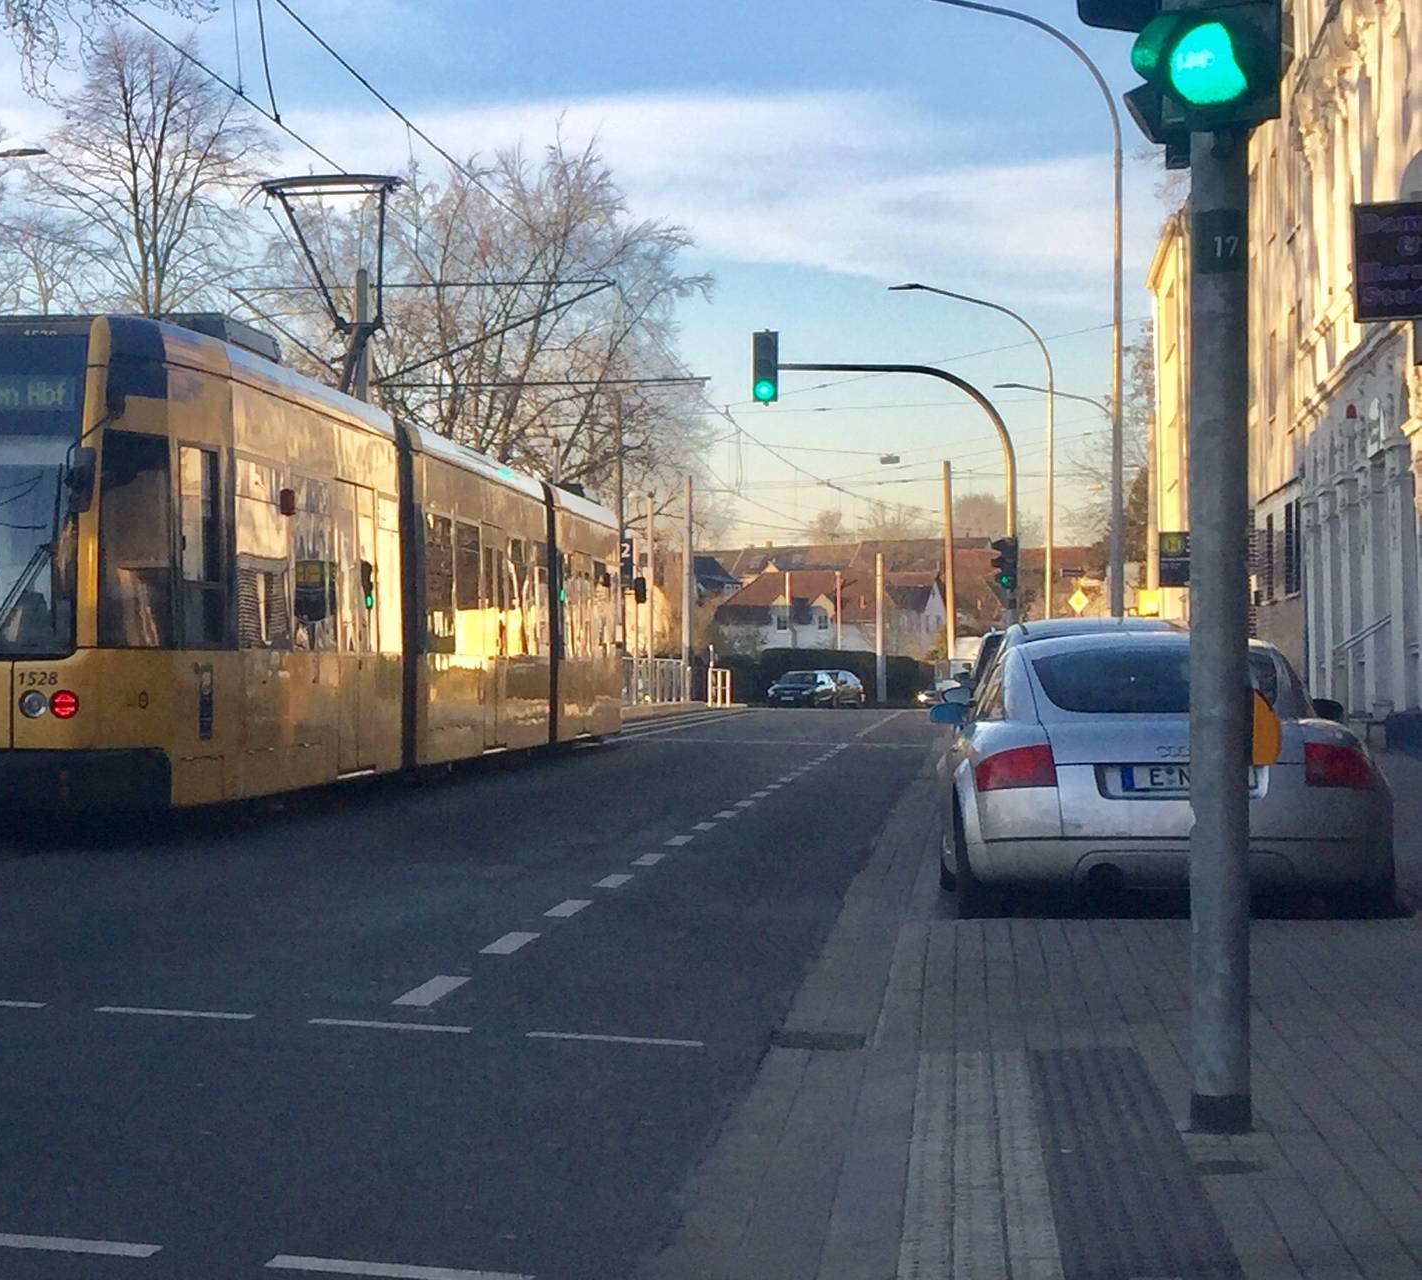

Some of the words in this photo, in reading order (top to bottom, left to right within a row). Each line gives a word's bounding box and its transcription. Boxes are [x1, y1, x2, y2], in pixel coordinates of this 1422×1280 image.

[1214, 235, 1239, 257] 17
[28, 381, 67, 406] Hbf
[620, 543, 631, 558] 2
[18, 671, 58, 686] 1528
